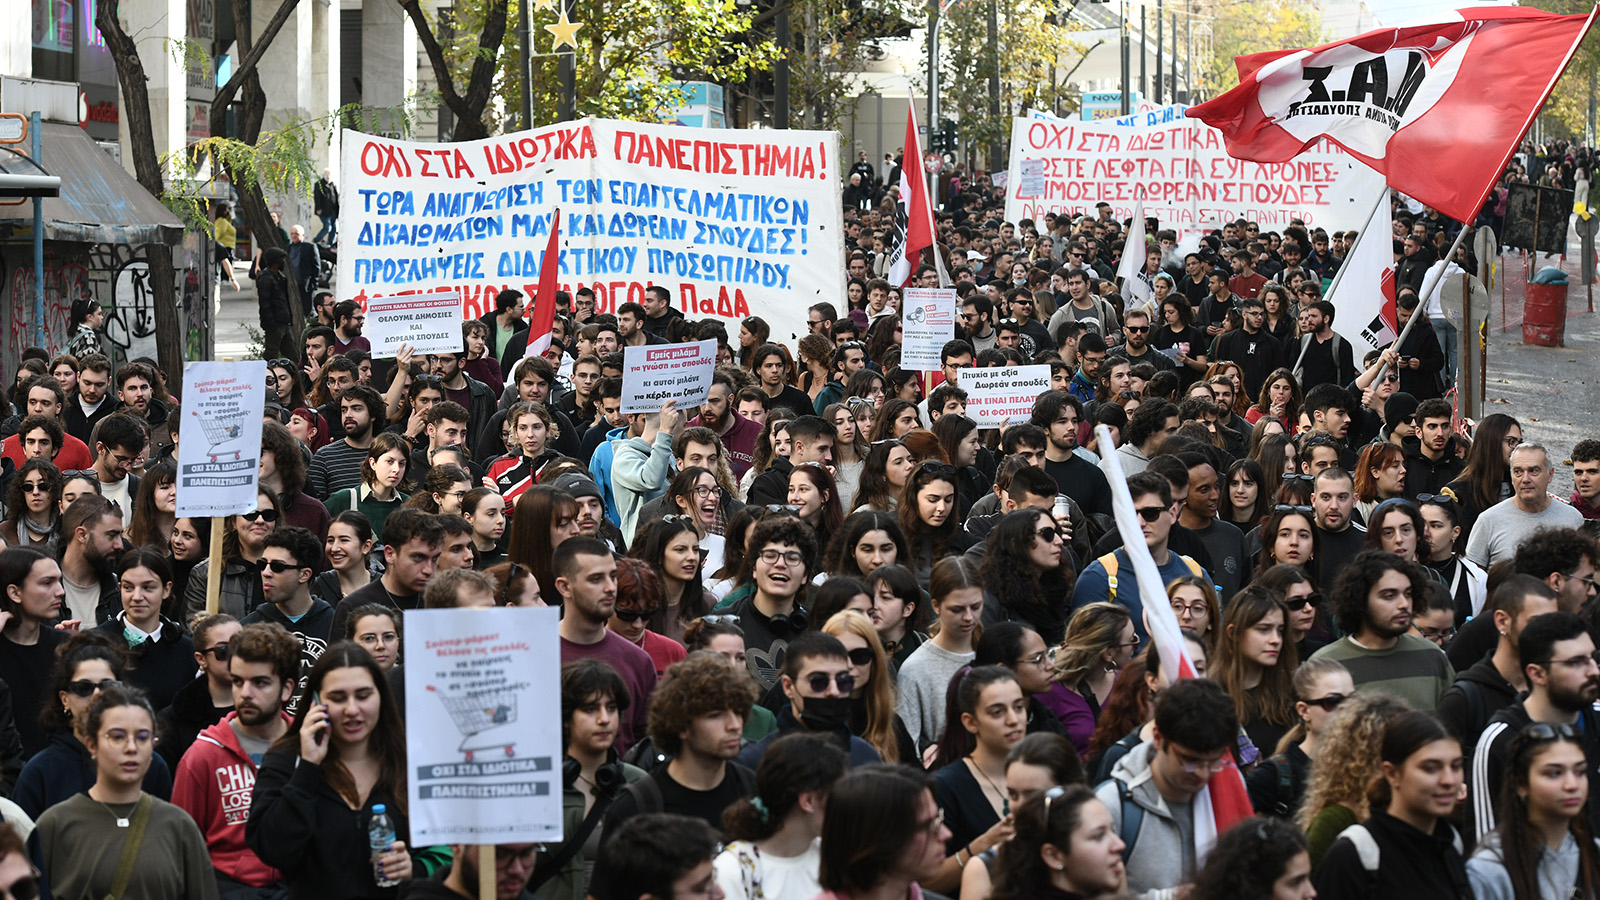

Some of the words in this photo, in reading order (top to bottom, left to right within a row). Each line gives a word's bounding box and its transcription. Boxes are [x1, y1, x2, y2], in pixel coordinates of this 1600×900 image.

[1029, 122, 1074, 150] ΟΧΙ
[1077, 132, 1120, 152] ΣΤΑ
[1127, 128, 1220, 150] ΙΔΙΩΤΙΚΑ
[361, 142, 411, 177] ΟΧΙ
[415, 148, 474, 178] ΣΤΑ
[484, 125, 598, 175] ΙΔΙΩΤΙΚΑ
[614, 131, 826, 180] ΠΑΝΕΠΙΣΤΗΜΙΑ!
[1094, 158, 1165, 178] ΛΕΦΤΑ
[1172, 158, 1202, 179] ΓΙΑ
[358, 190, 414, 216] ΤΩΡΑ
[422, 181, 543, 217] ΑΝΑΓΝΩΡΙΣΗ
[557, 179, 602, 204] ΤΩΝ
[609, 180, 809, 226] ΕΠΑΓΓΕΛΜΑΤΙΚΩΝ
[1200, 209, 1234, 224] ΣΤΟ
[358, 216, 503, 246] ΔΙΚΑΙΩΜΑΤΩΝ
[569, 214, 605, 236] ΚΑΙ
[608, 212, 687, 240] ΔΩΡΕΑΝ
[693, 220, 808, 256] ΣΠΟΥΔΕΣ!
[354, 252, 484, 284] ΠΡΟΣΛΗΨΕΙΣ
[497, 246, 638, 277] ΔΙΔΚΤΙΚΟΥ
[648, 248, 792, 289] ΠΡΟΣΩΠΙΚΟΥ.
[680, 283, 750, 318] ΠαΔΑ
[378, 314, 413, 322] ΘΕΛΟΥΜΕ
[415, 312, 452, 320] ΔΗΜΟΣΙΕΣ
[385, 335, 414, 343] ΔΩΡΕΑΝ
[417, 332, 449, 340] ΣΠΟΥΔΕΣ
[672, 349, 696, 358] μιλάμε
[642, 362, 668, 372] γνώση
[682, 357, 712, 367] σπουδές
[654, 377, 675, 385] αυτοί
[677, 375, 699, 385] μιλάνε
[962, 371, 988, 379] Πτυχία
[1001, 369, 1018, 378] αξία
[975, 381, 1009, 389] Δωρεάν
[1012, 378, 1048, 387] σπουδές
[646, 391, 671, 400] κέρδη
[683, 386, 704, 396] ζημιές
[991, 408, 1031, 416] ΦΟΙΤΗΤΕΣ
[222, 463, 249, 471] ΙΔΙΩΤΙΚΑ
[190, 477, 247, 486] ΠΑΝΕΠΙΣΤΗΜΙΑ!
[431, 765, 455, 777] ΟΧΙ
[457, 763, 481, 775] ΣΤΑ
[483, 760, 536, 774] ΙΔΙΩΤΙΚΑ
[431, 783, 536, 798] ΠΑΝΕΠΙΣΤΗΜΙΑ!
[222, 792, 252, 809] LOS
